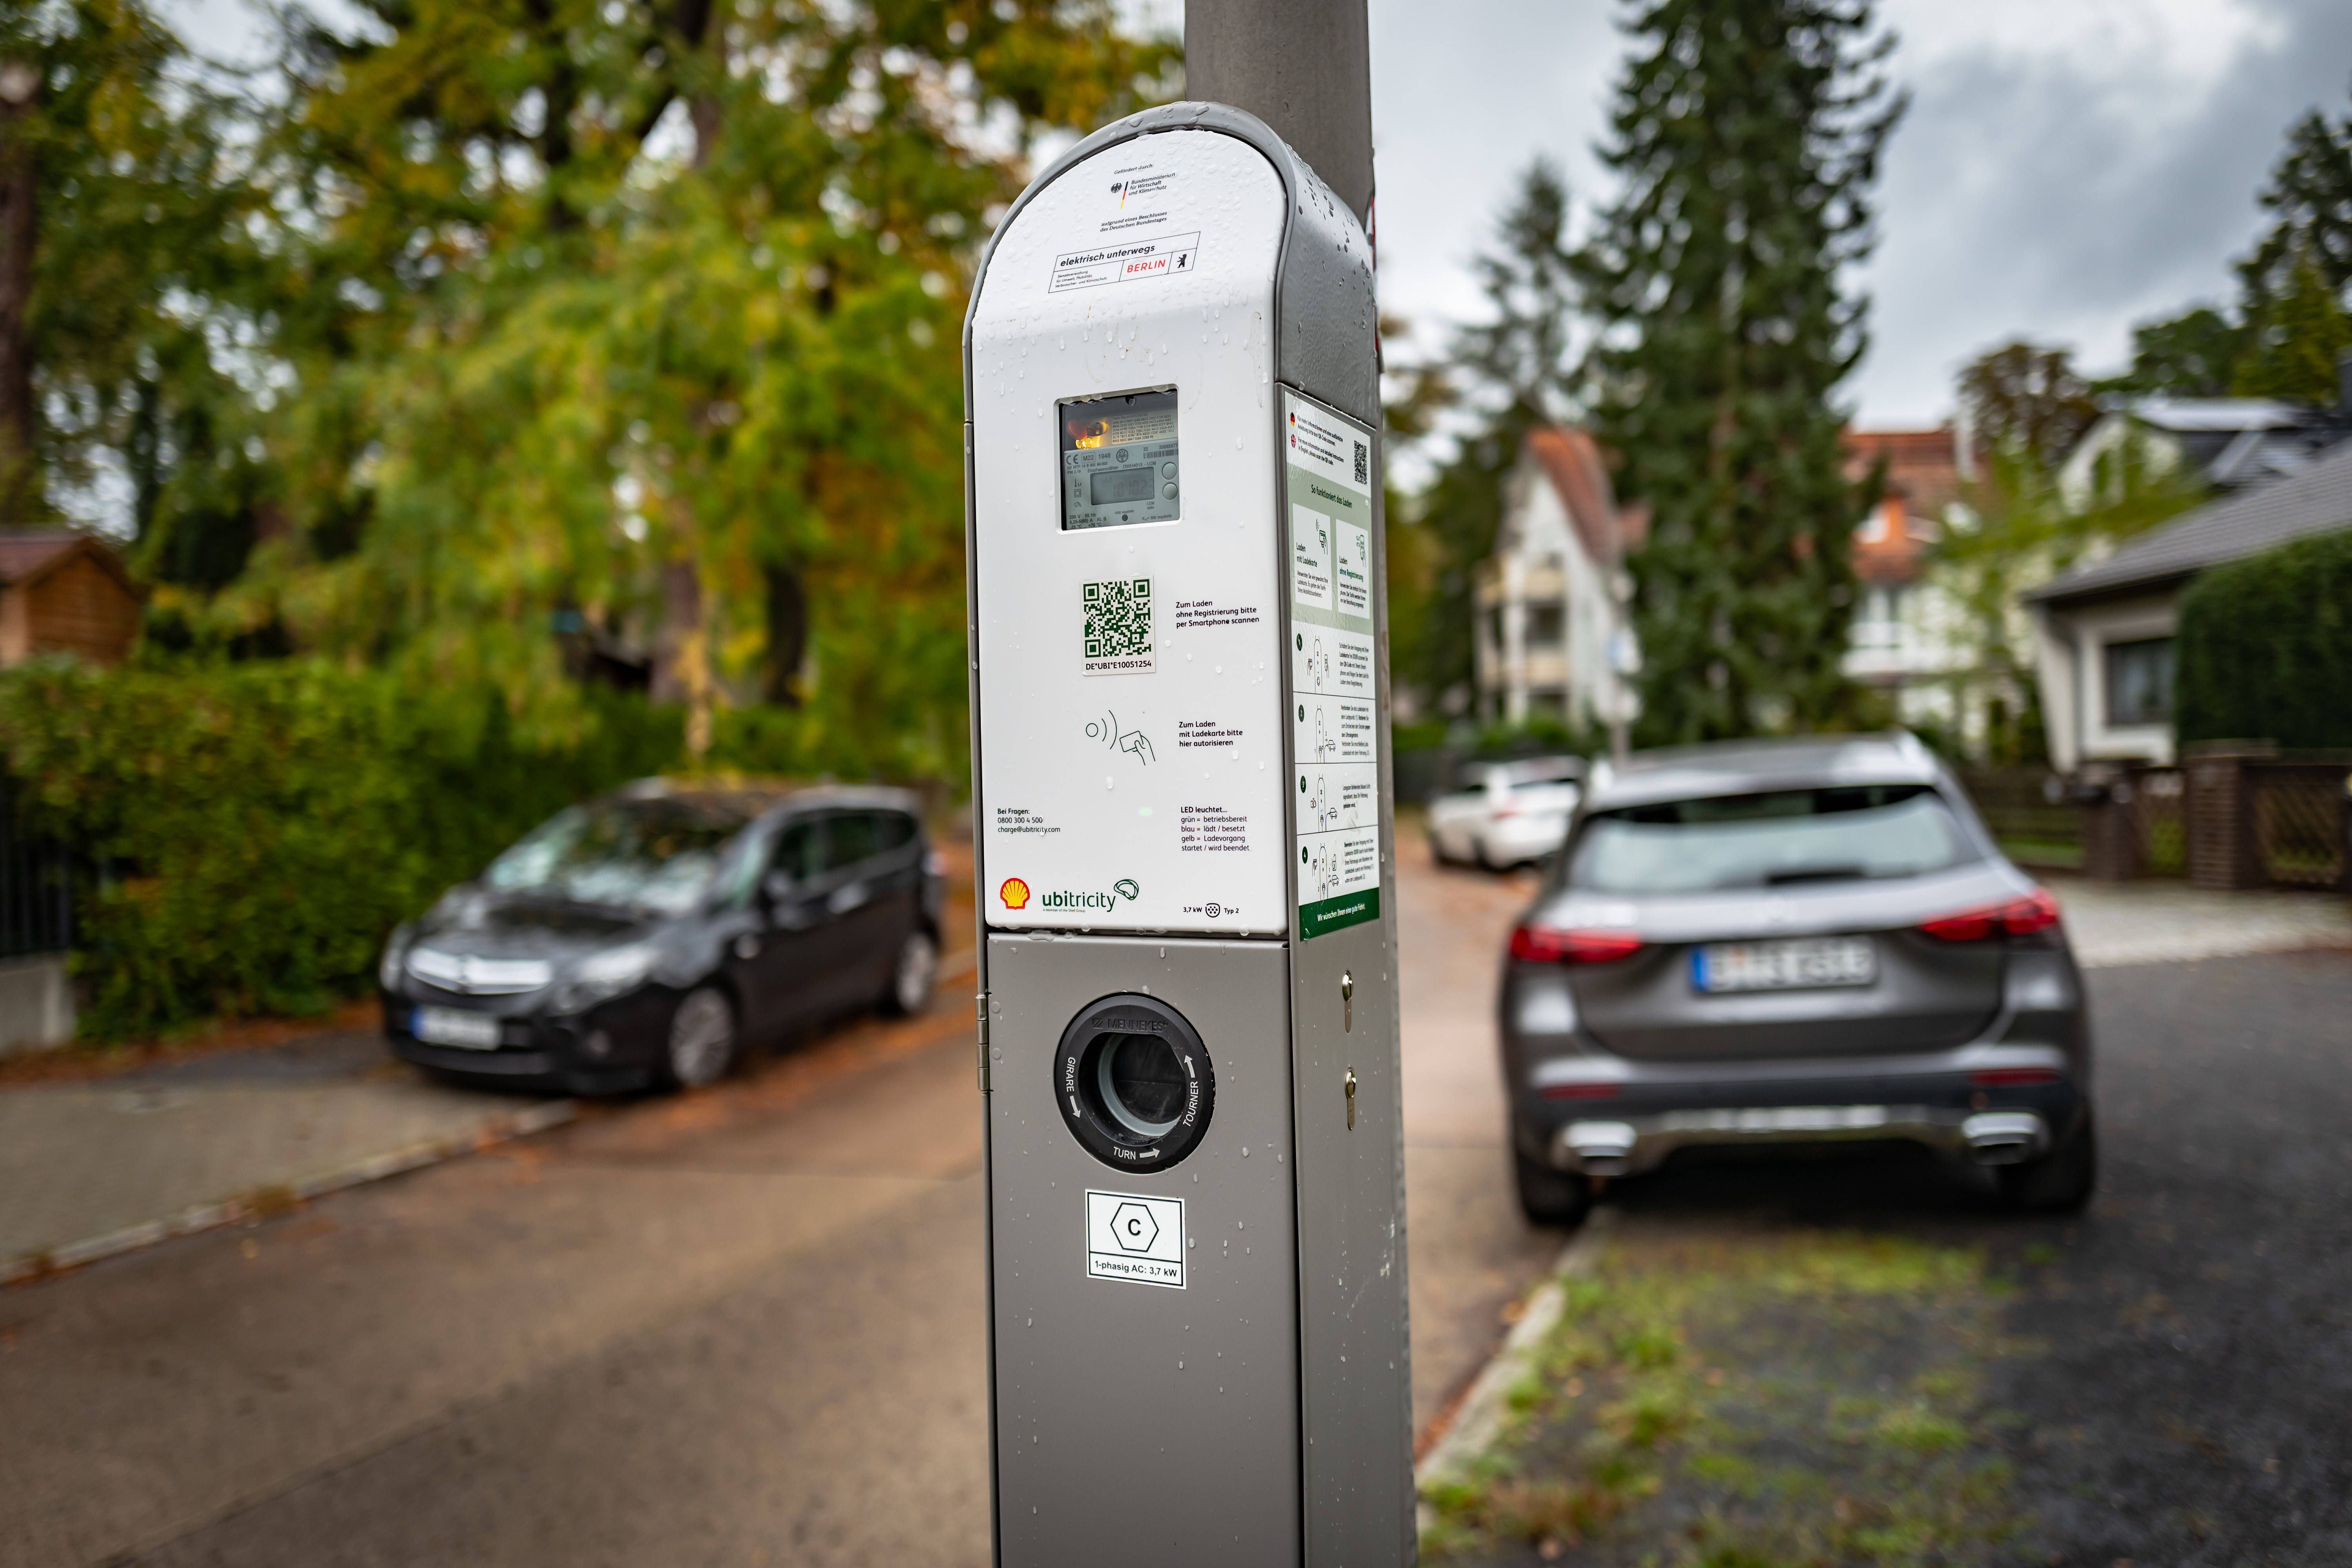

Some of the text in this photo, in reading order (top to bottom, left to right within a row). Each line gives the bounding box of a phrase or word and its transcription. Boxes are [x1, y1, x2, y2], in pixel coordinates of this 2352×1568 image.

[1131, 172, 1175, 184] Bundesministerium
[1138, 180, 1161, 189] Wirtschaft
[1139, 185, 1167, 194] Klimaschutz
[1136, 217, 1167, 225] Bundestages
[1060, 245, 1154, 267] elektrisch unterwegs
[1127, 260, 1166, 273] BERLIN
[1308, 420, 1322, 432] Informationen
[1298, 424, 1308, 434] Anleitung
[1318, 434, 1327, 442] QR-Code
[1308, 441, 1320, 451] information
[1311, 485, 1316, 494] So
[1317, 487, 1336, 502] funktioniert
[1343, 497, 1352, 508] Laden
[1296, 543, 1306, 552] Laden
[1303, 556, 1317, 567] Ladekarte
[1194, 609, 1238, 617] Registrierung
[1043, 891, 1116, 912] ubitricity
[1323, 911, 1337, 920] wünschen
[1065, 1057, 1076, 1093] GIRARE
[1183, 1081, 1199, 1127] TOURNER
[1113, 1147, 1136, 1160] TURN
[1128, 1219, 1141, 1236] C
[1095, 1261, 1177, 1277] 1-phasig AC: 3,7 kW
